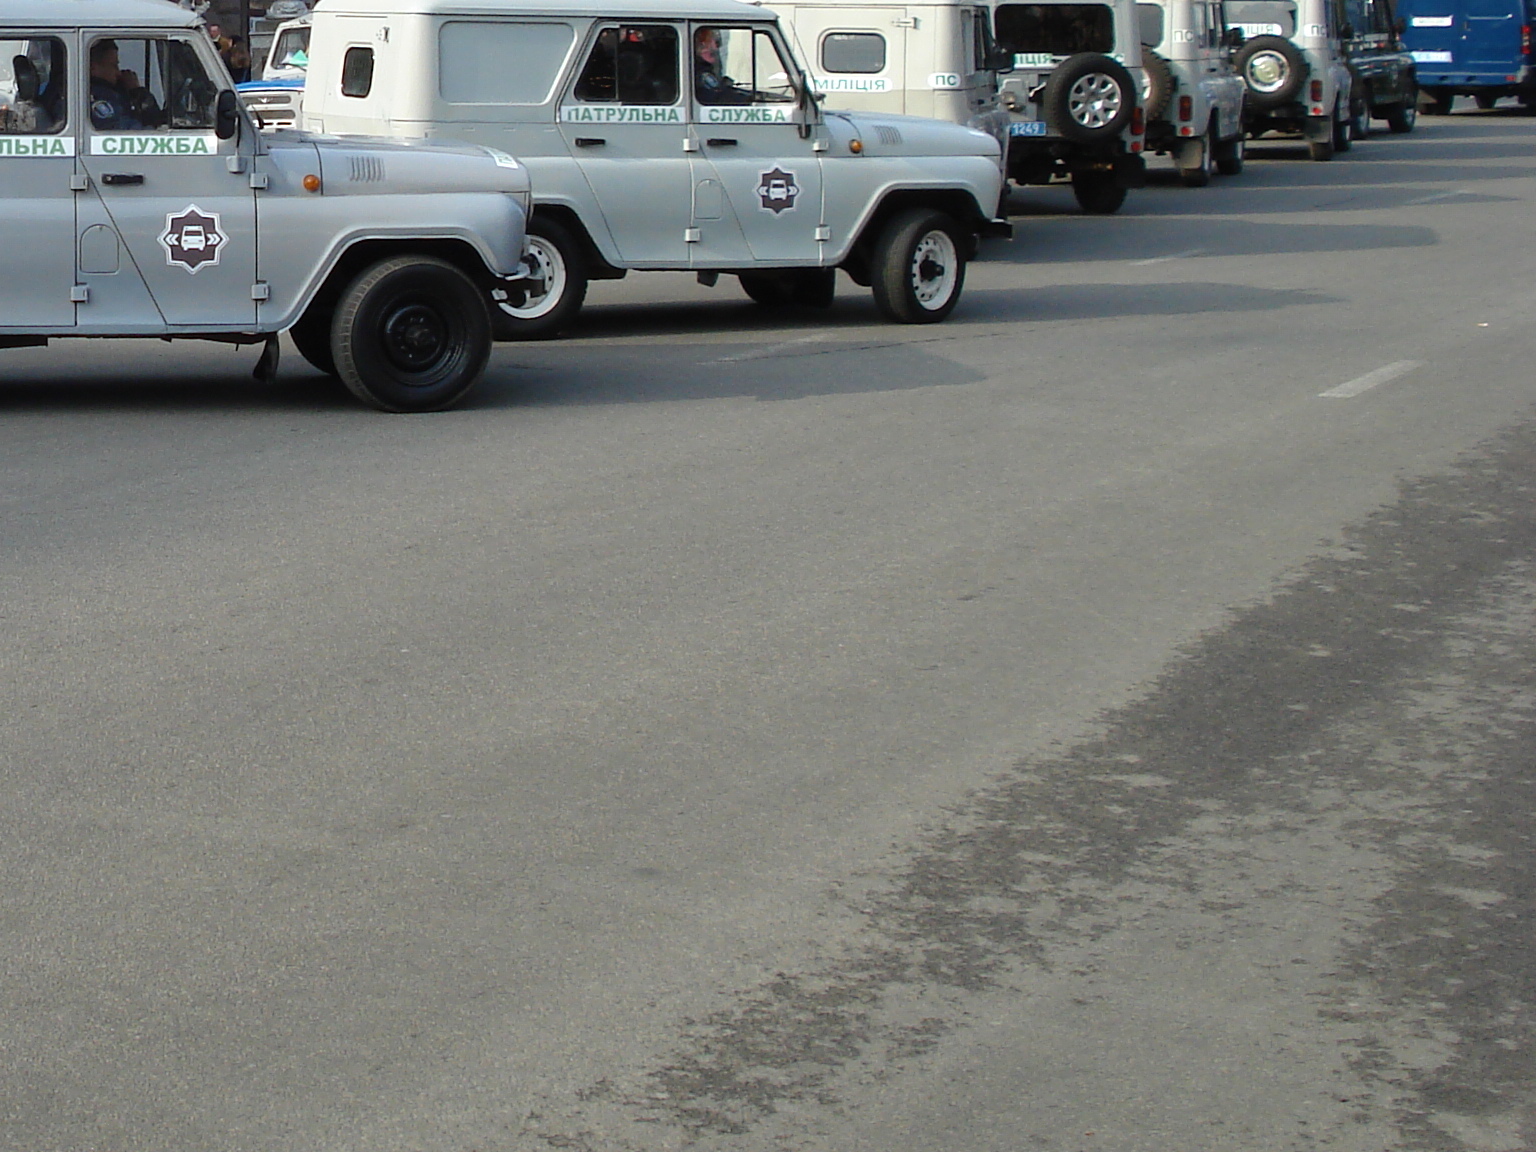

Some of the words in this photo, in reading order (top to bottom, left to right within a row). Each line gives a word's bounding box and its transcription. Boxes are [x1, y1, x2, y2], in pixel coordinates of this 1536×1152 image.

[1174, 30, 1194, 42] ПС
[815, 79, 886, 91] МІЛІЦІЯ
[935, 74, 957, 86] ПС
[567, 108, 679, 122] ПАТРУЛЬНА
[708, 108, 786, 122] СЛУЖБА
[101, 137, 209, 154] СЛУЖБА
